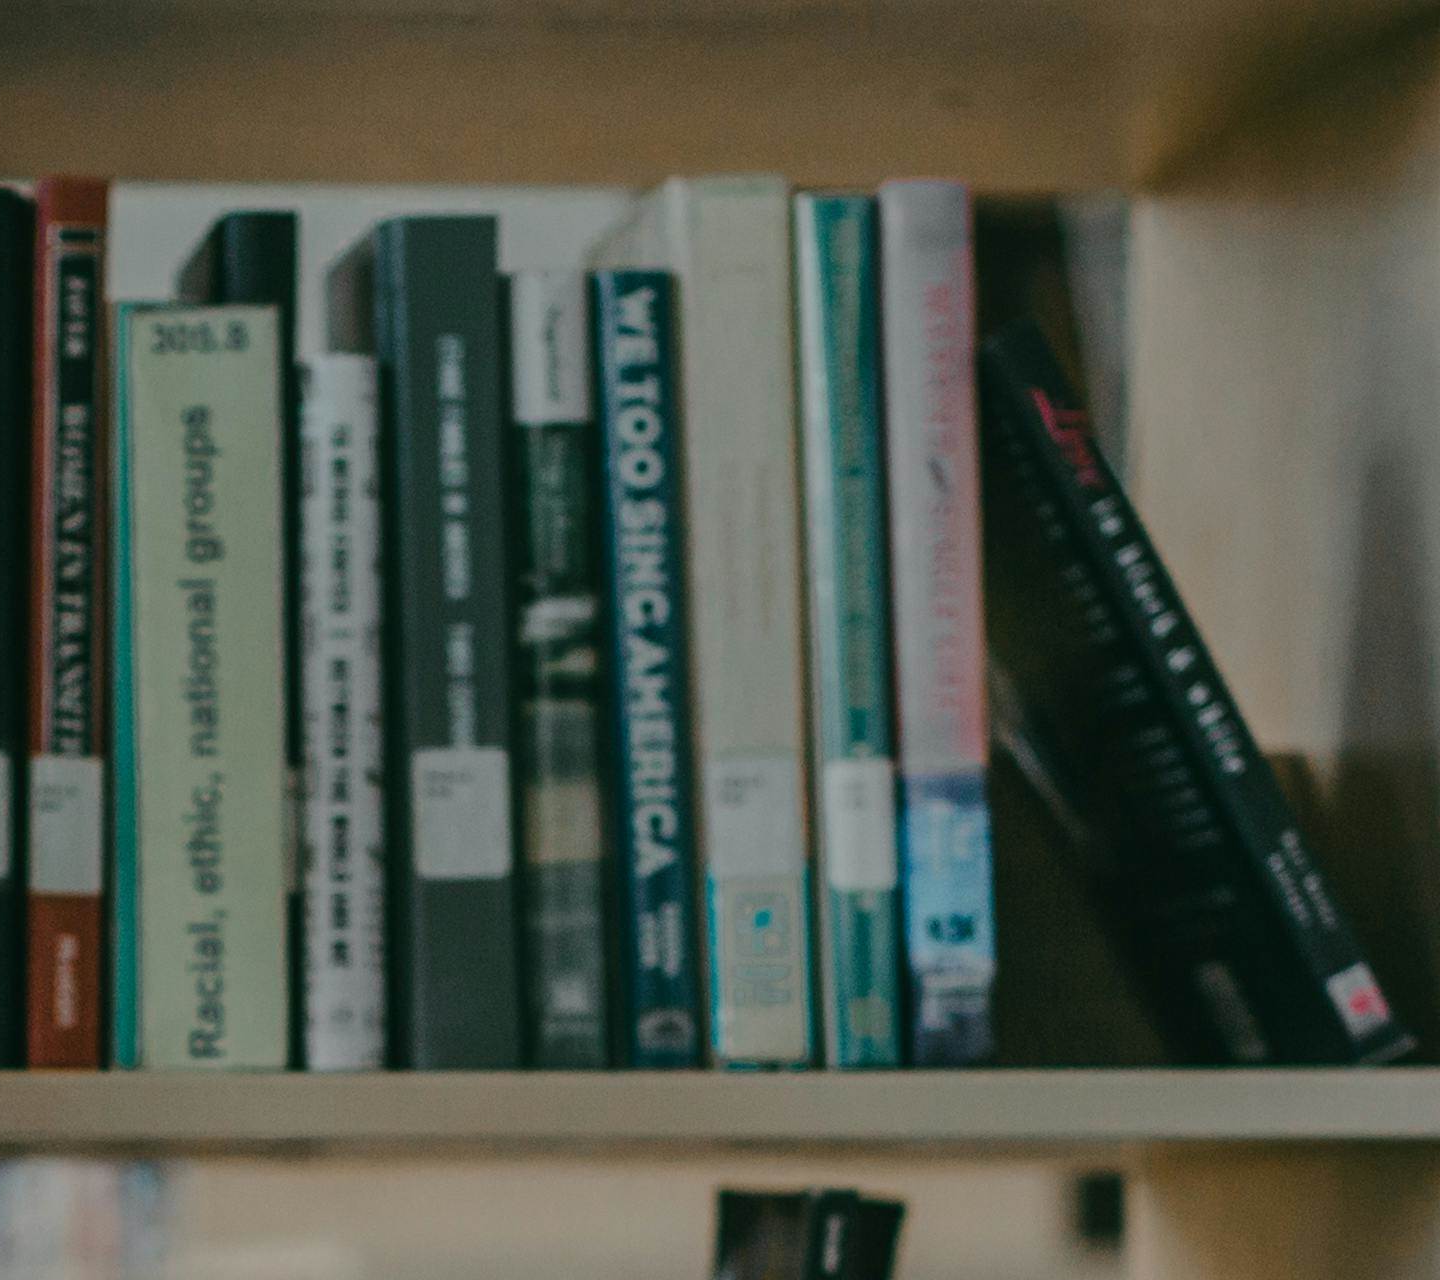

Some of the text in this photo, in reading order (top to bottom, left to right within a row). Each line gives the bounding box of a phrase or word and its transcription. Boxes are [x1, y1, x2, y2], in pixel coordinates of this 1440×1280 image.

[616, 287, 659, 362] WE
[621, 369, 665, 488] TOO
[623, 496, 670, 631] SING
[629, 636, 679, 880] AMERICA
